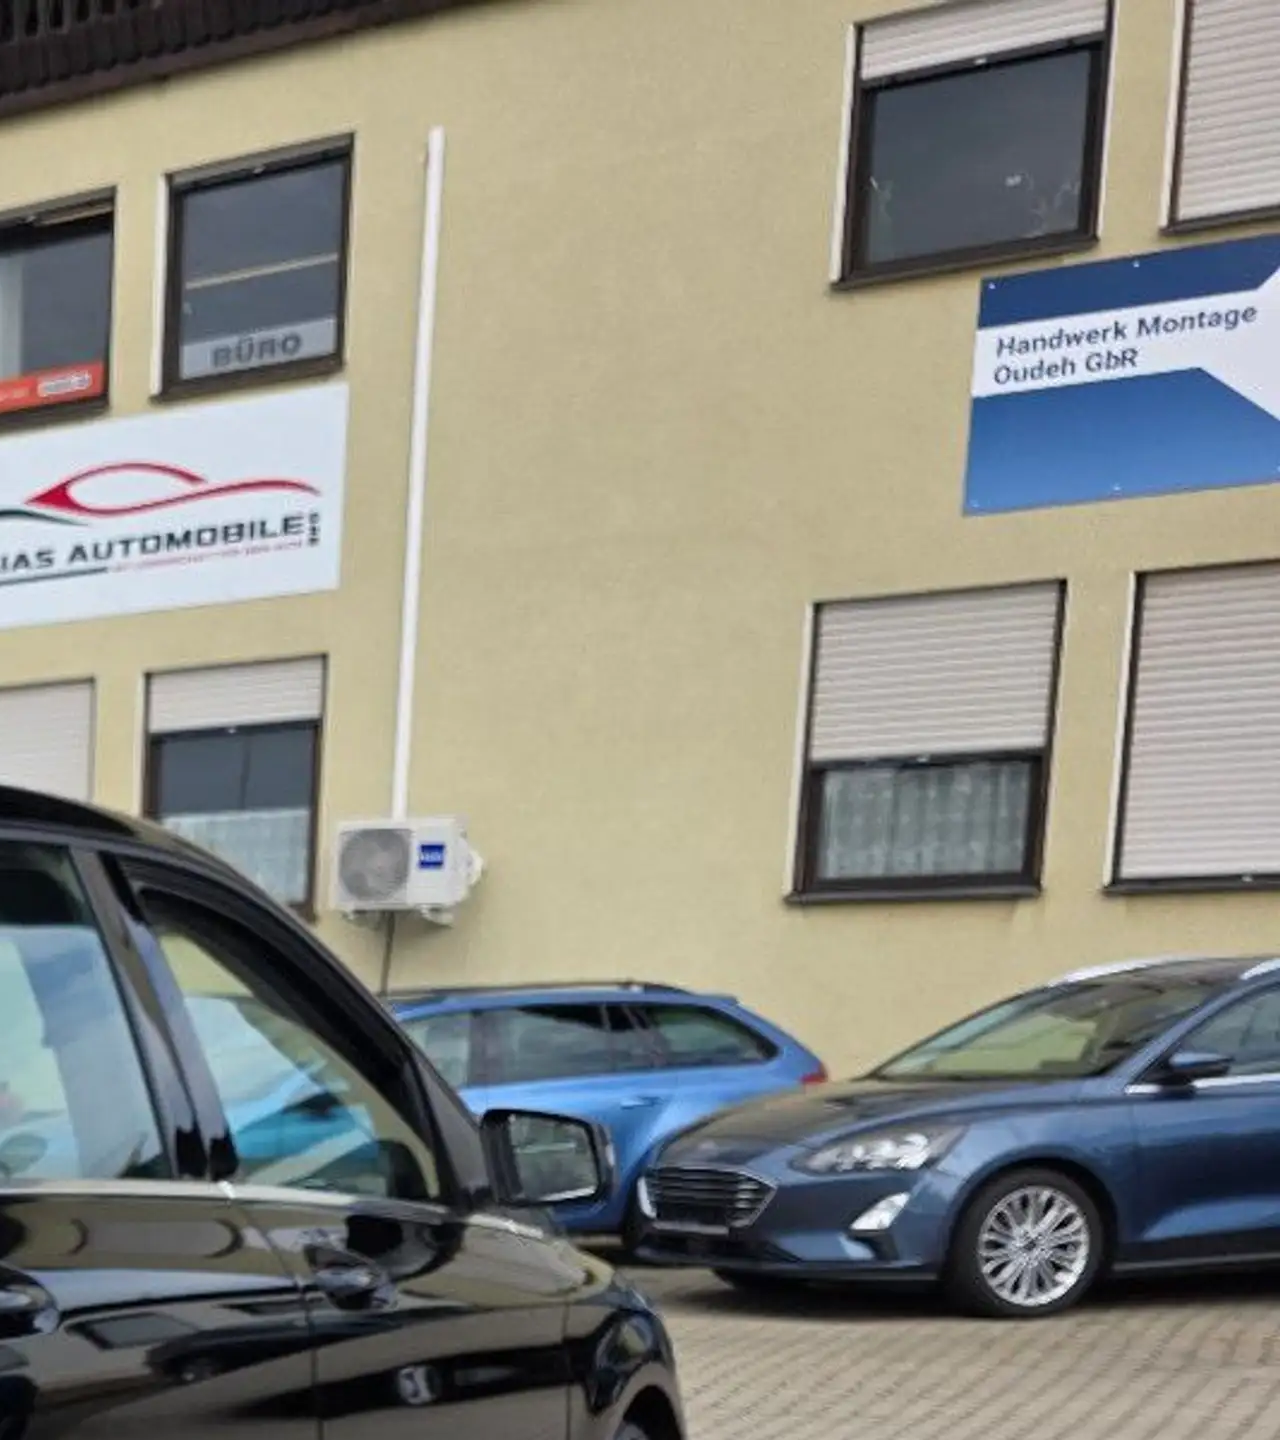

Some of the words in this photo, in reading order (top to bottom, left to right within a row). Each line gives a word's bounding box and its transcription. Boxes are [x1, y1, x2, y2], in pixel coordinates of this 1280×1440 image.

[212, 334, 302, 366] BÜRO
[996, 321, 1127, 356] Handwerk
[1137, 306, 1257, 337] Montage
[994, 356, 1076, 385] Oudeh
[1085, 347, 1139, 371] GbR
[69, 516, 303, 563] AUTOMOBILE
